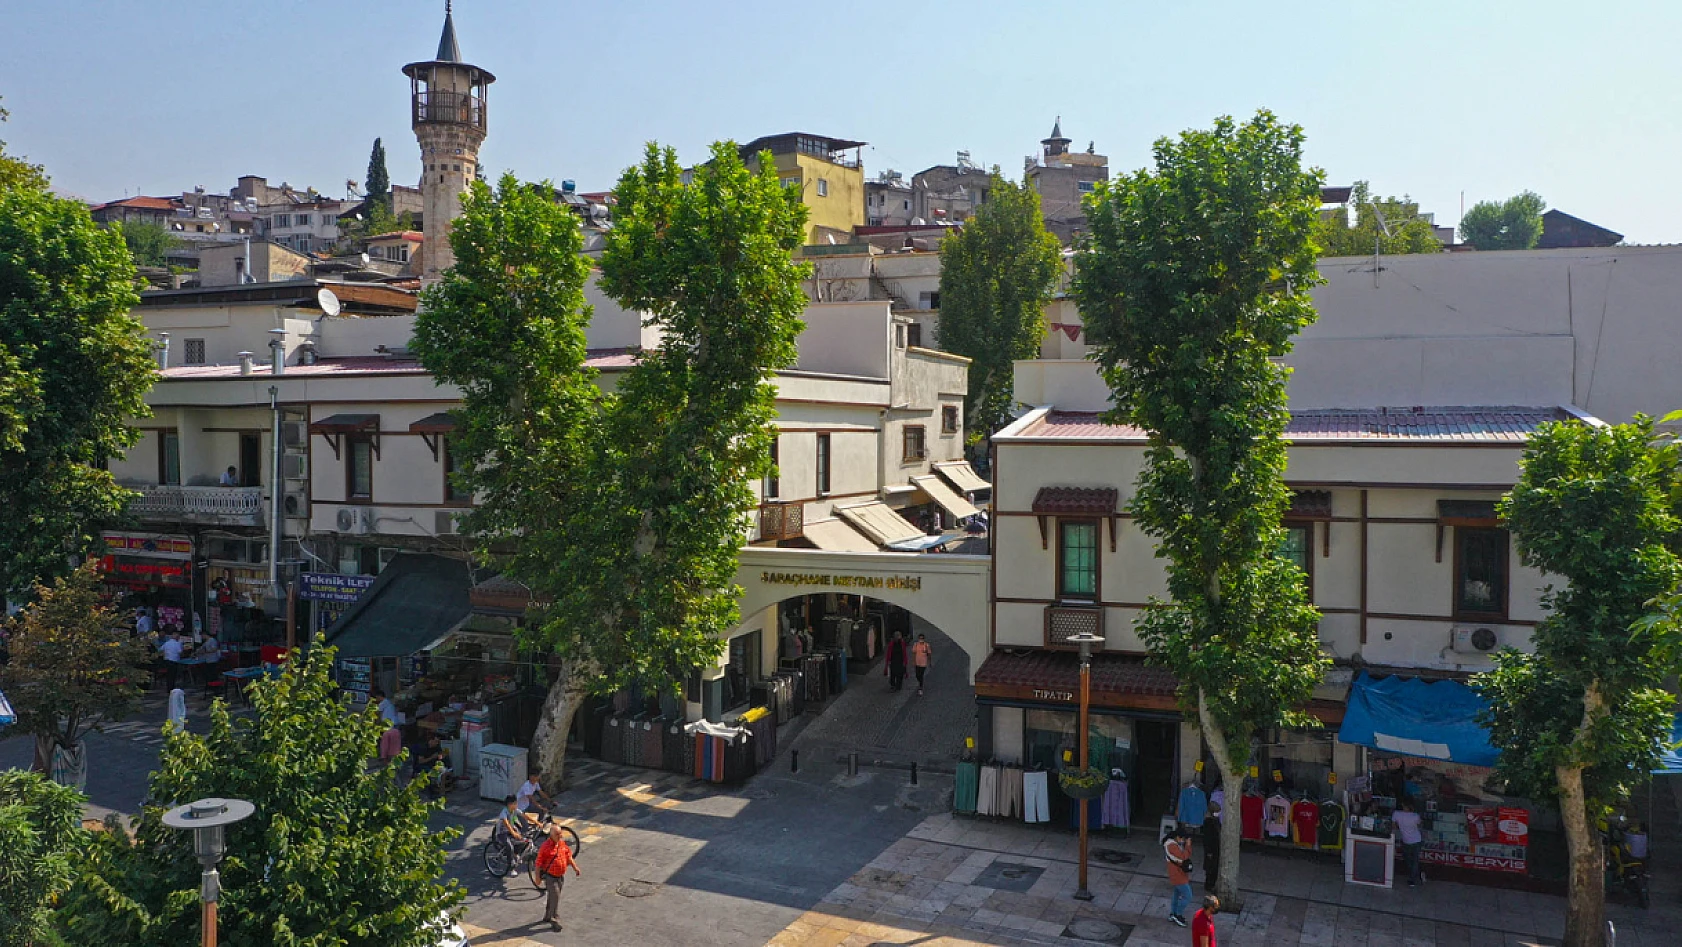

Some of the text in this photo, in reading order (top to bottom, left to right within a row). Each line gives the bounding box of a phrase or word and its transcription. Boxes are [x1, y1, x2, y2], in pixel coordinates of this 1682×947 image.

[302, 575, 374, 588] Teknik İLET
[761, 572, 831, 587] SARAÇHANE
[832, 575, 883, 588] MEYDAN
[1463, 855, 1526, 869] SERVİS
